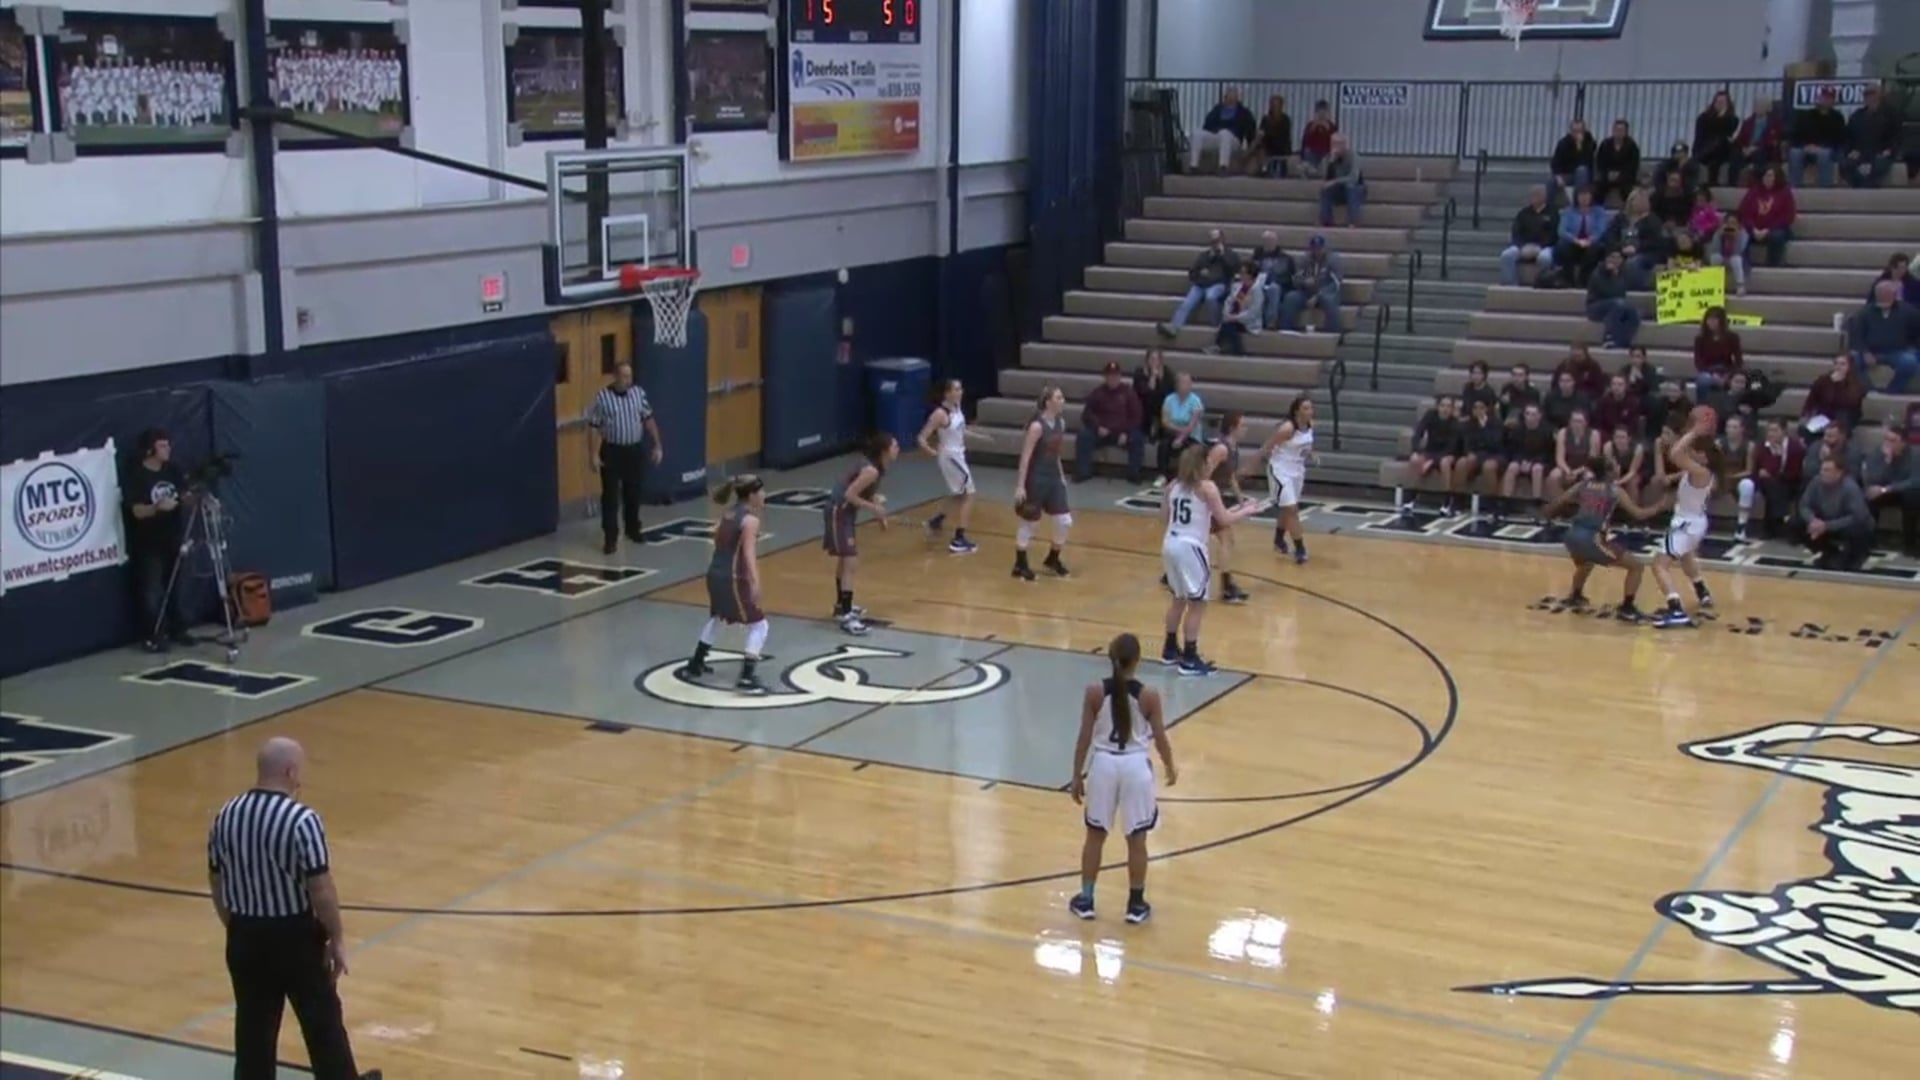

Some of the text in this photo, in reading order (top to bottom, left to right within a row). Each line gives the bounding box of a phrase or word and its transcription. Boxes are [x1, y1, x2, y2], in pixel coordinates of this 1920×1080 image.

[806, 59, 876, 77] Deerfoot Trails
[26, 477, 81, 511] MTC
[26, 503, 86, 528] SPORTS
[1172, 498, 1191, 524] 15
[2, 543, 119, 583] www.mtcsports.net
